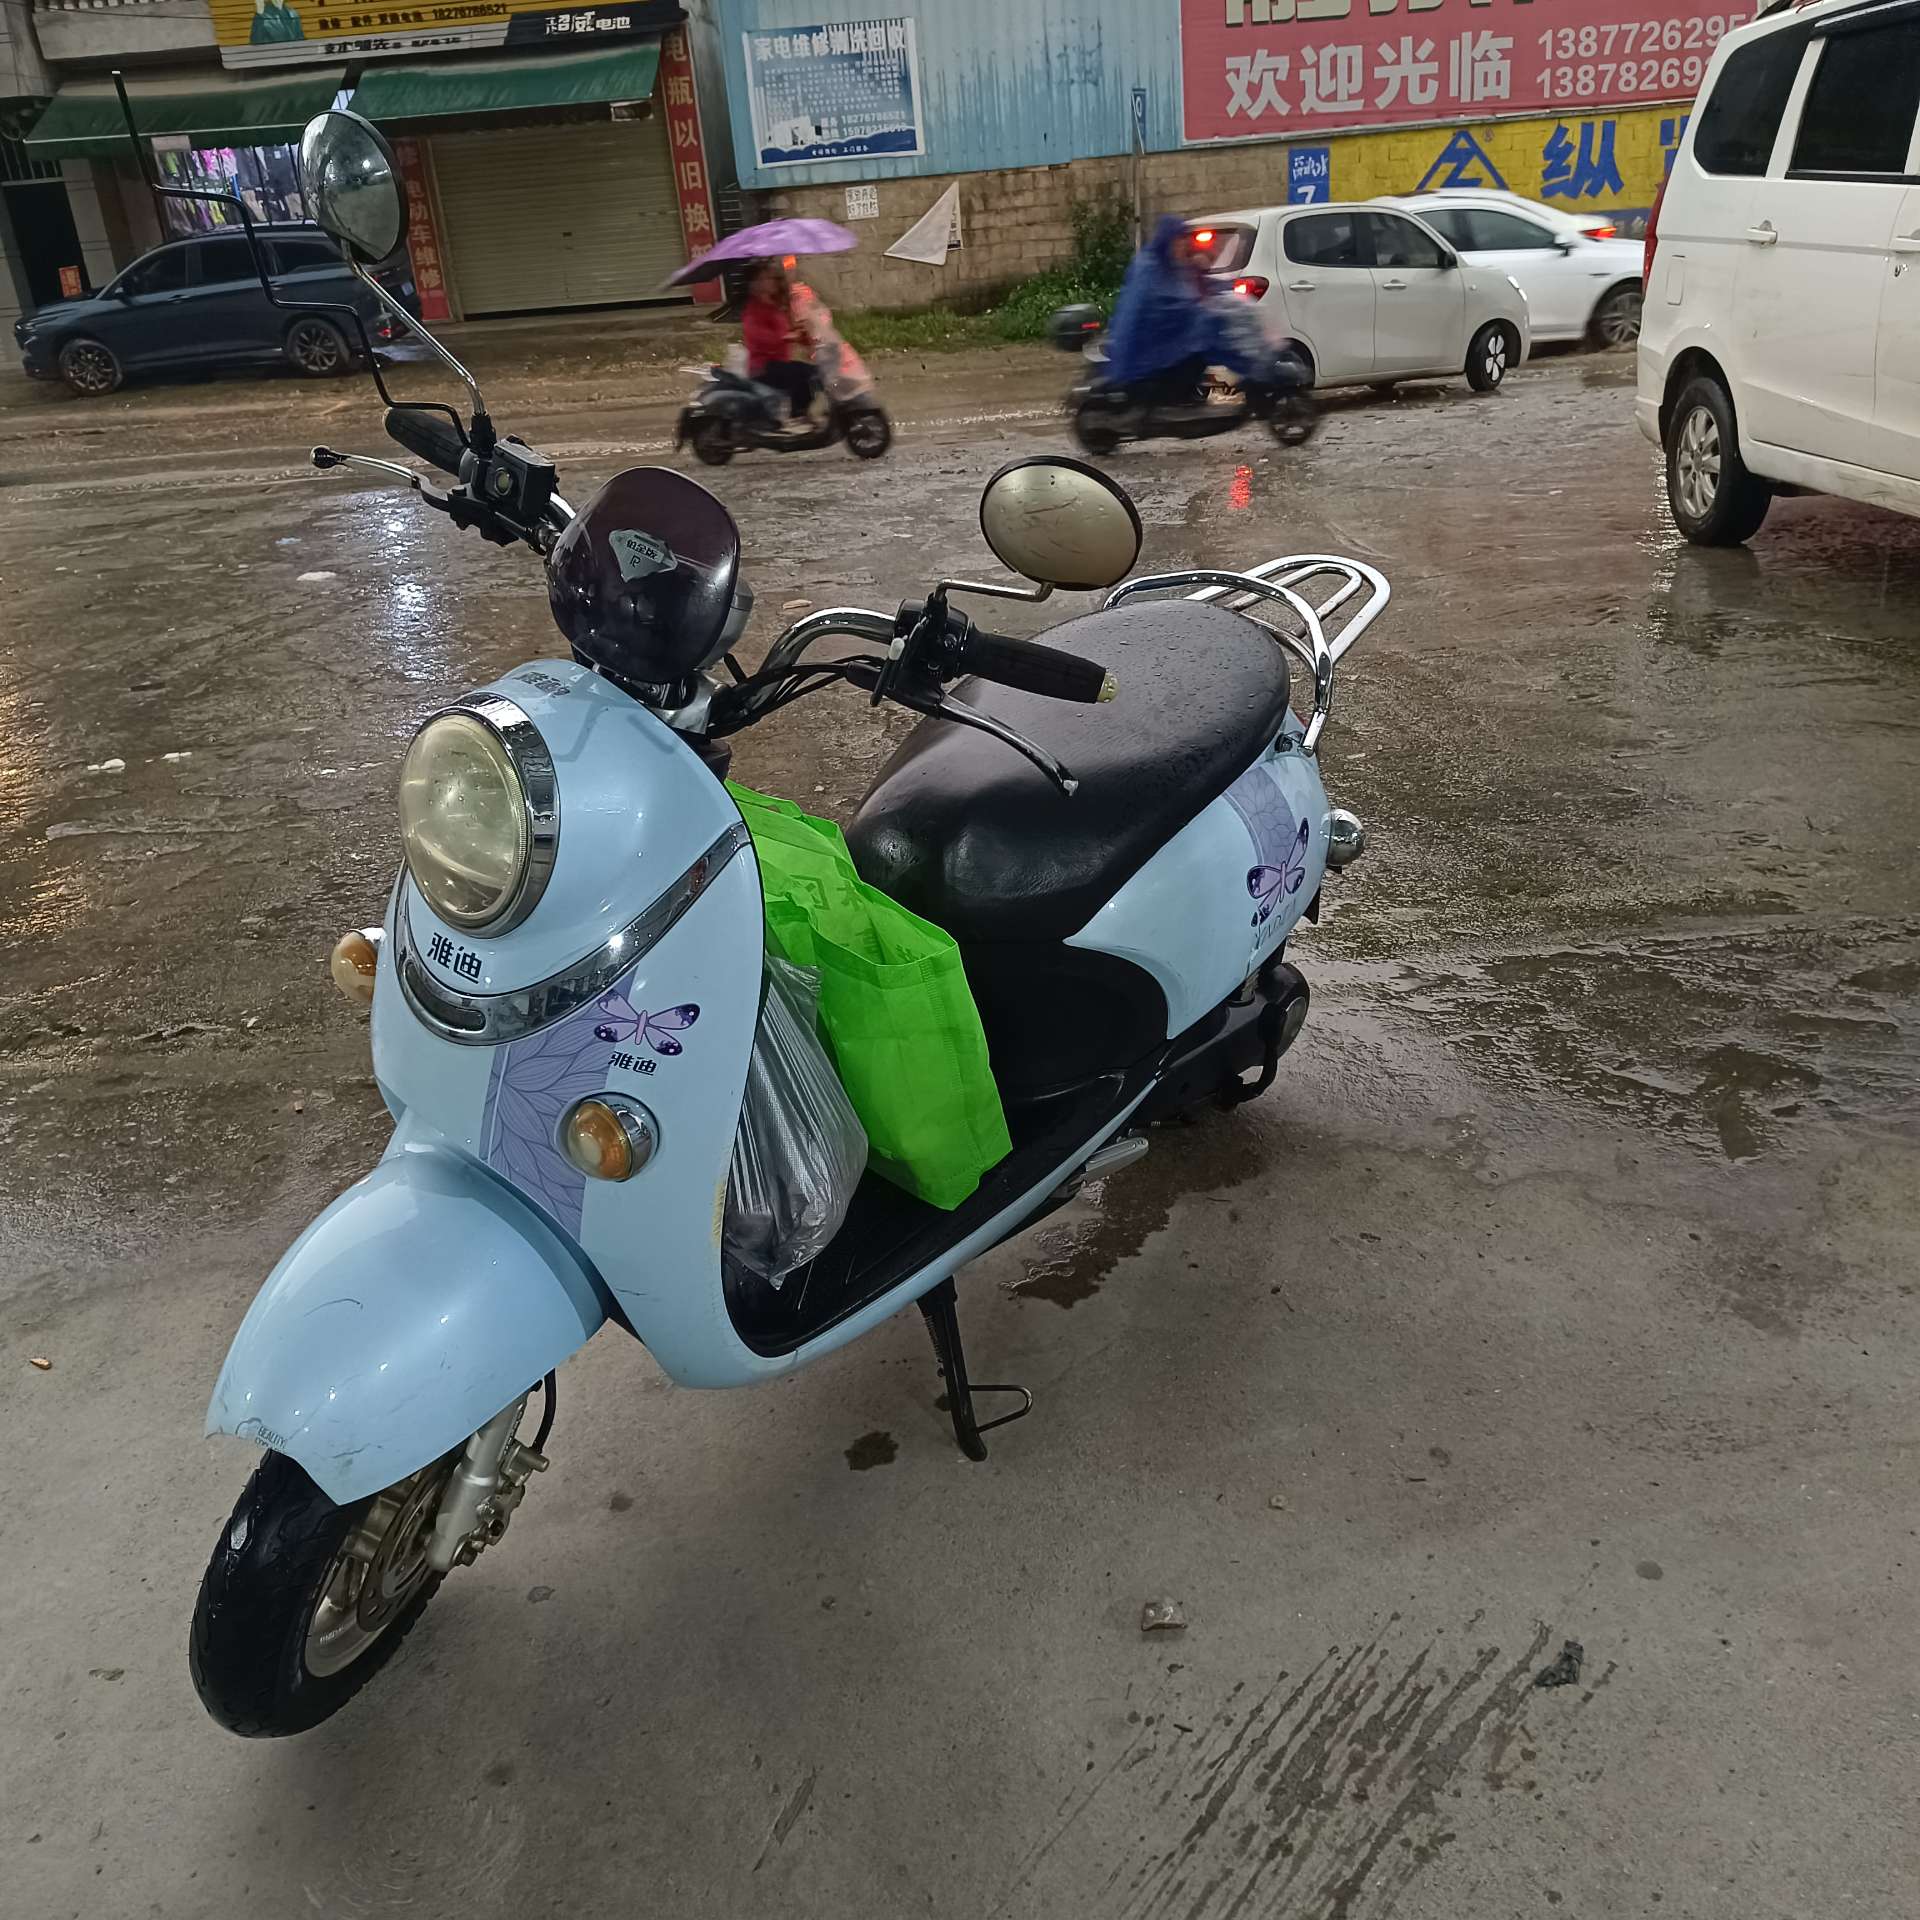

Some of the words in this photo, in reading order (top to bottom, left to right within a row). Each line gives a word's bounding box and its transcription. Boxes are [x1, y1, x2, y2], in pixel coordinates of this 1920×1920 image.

[546, 11, 631, 35] 超威电池
[1538, 14, 1757, 60] 138772629
[1225, 30, 1514, 120] 欢迎光临
[1536, 56, 1712, 98] 13878269
[427, 932, 482, 984] 雅迪
[608, 1051, 657, 1076] 雅迪
